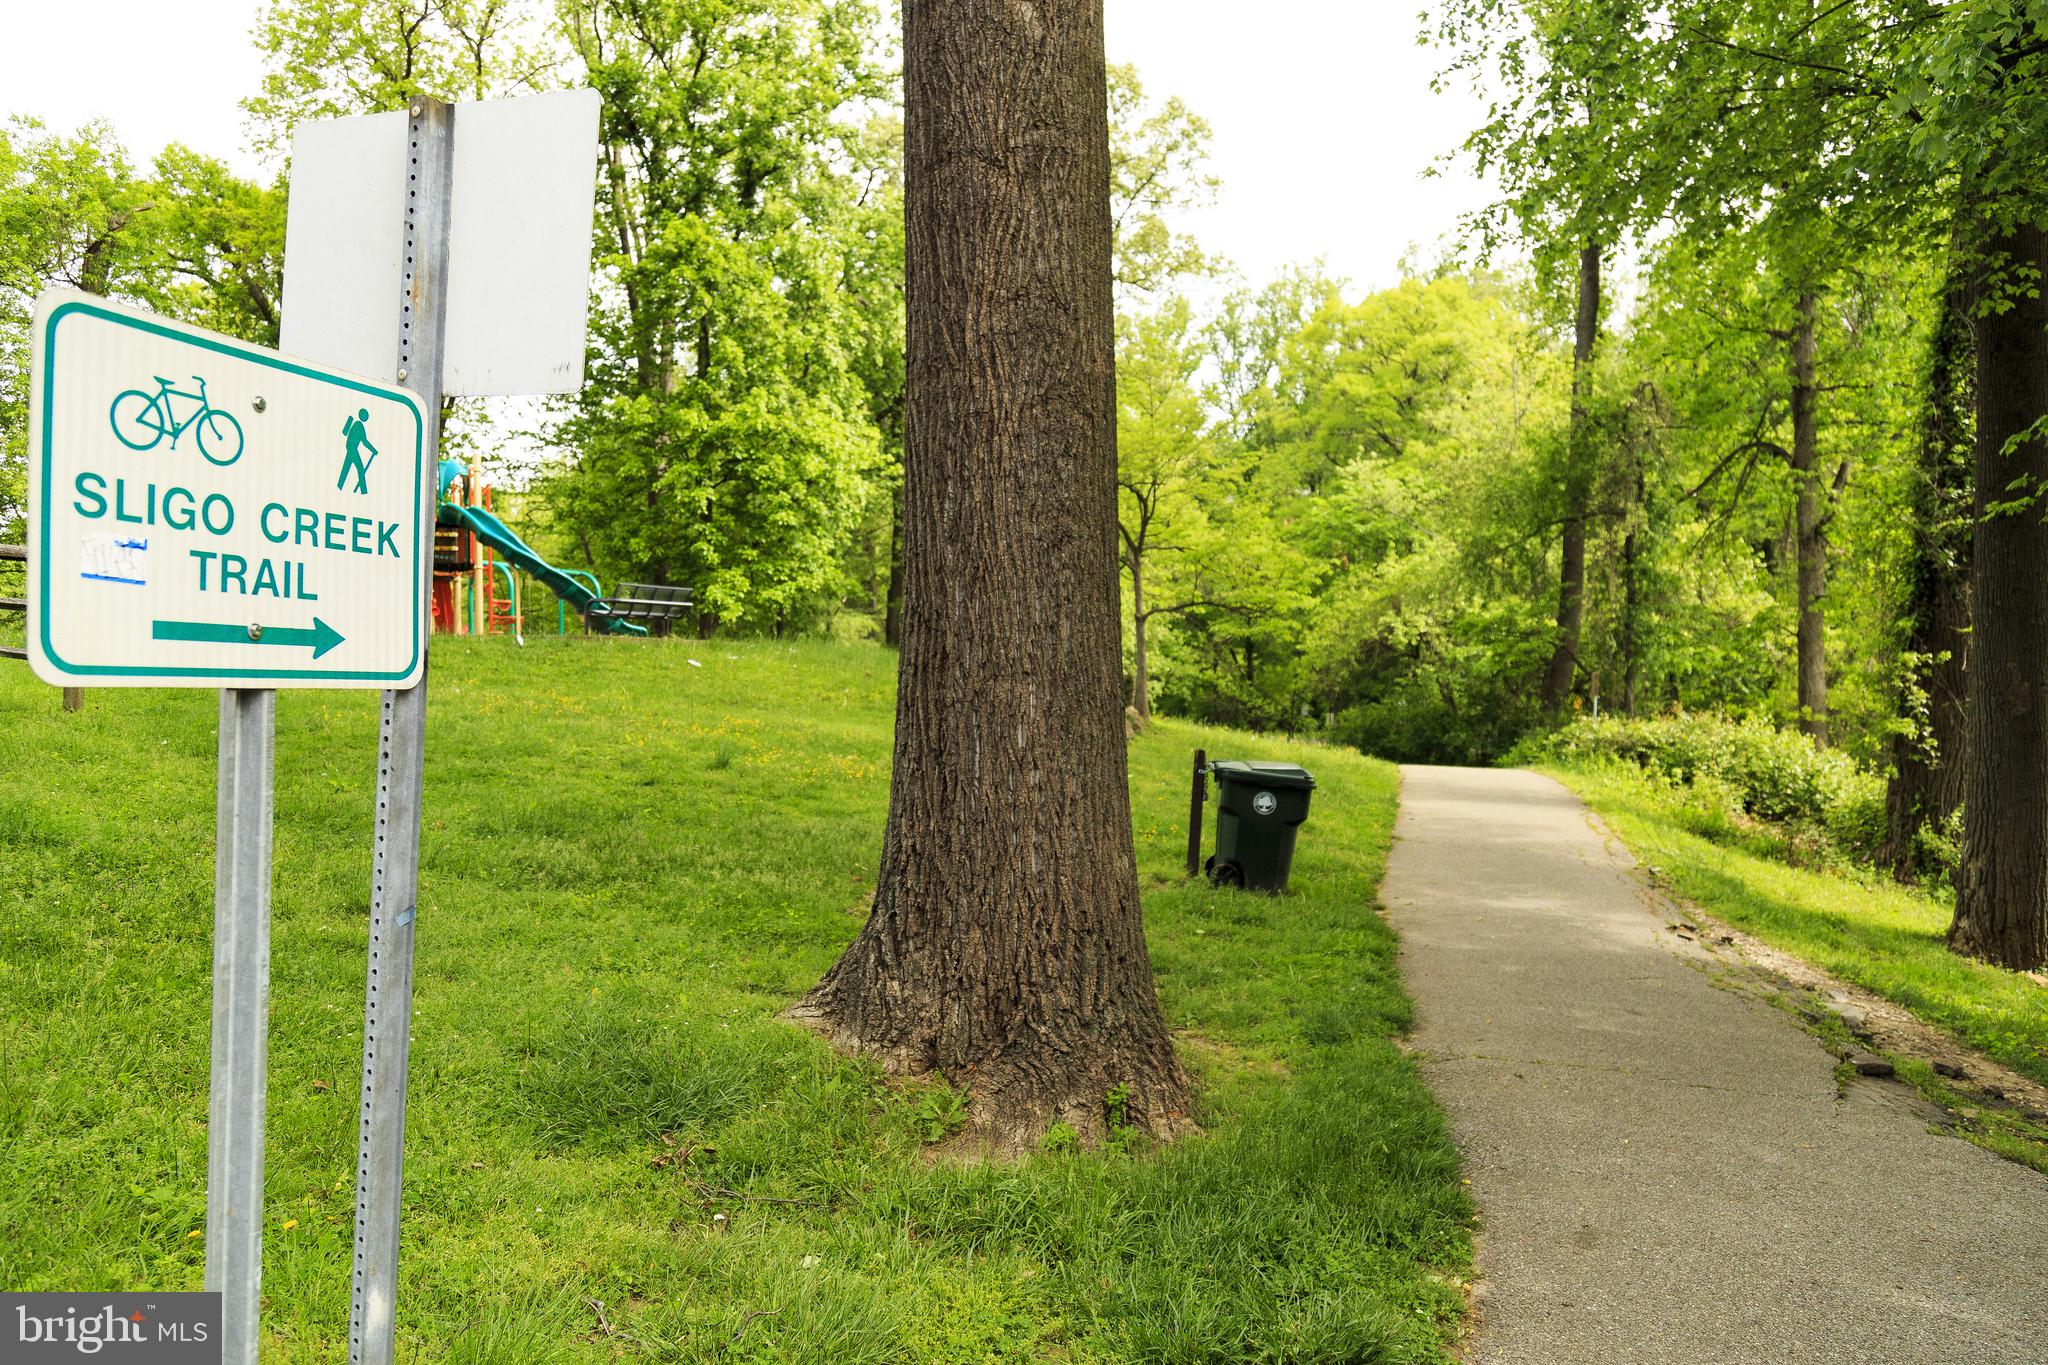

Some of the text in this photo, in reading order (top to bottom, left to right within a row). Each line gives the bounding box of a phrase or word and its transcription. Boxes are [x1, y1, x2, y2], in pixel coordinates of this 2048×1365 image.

[73, 471, 401, 558] SLIGO CREEK
[190, 549, 318, 600] TRAIL
